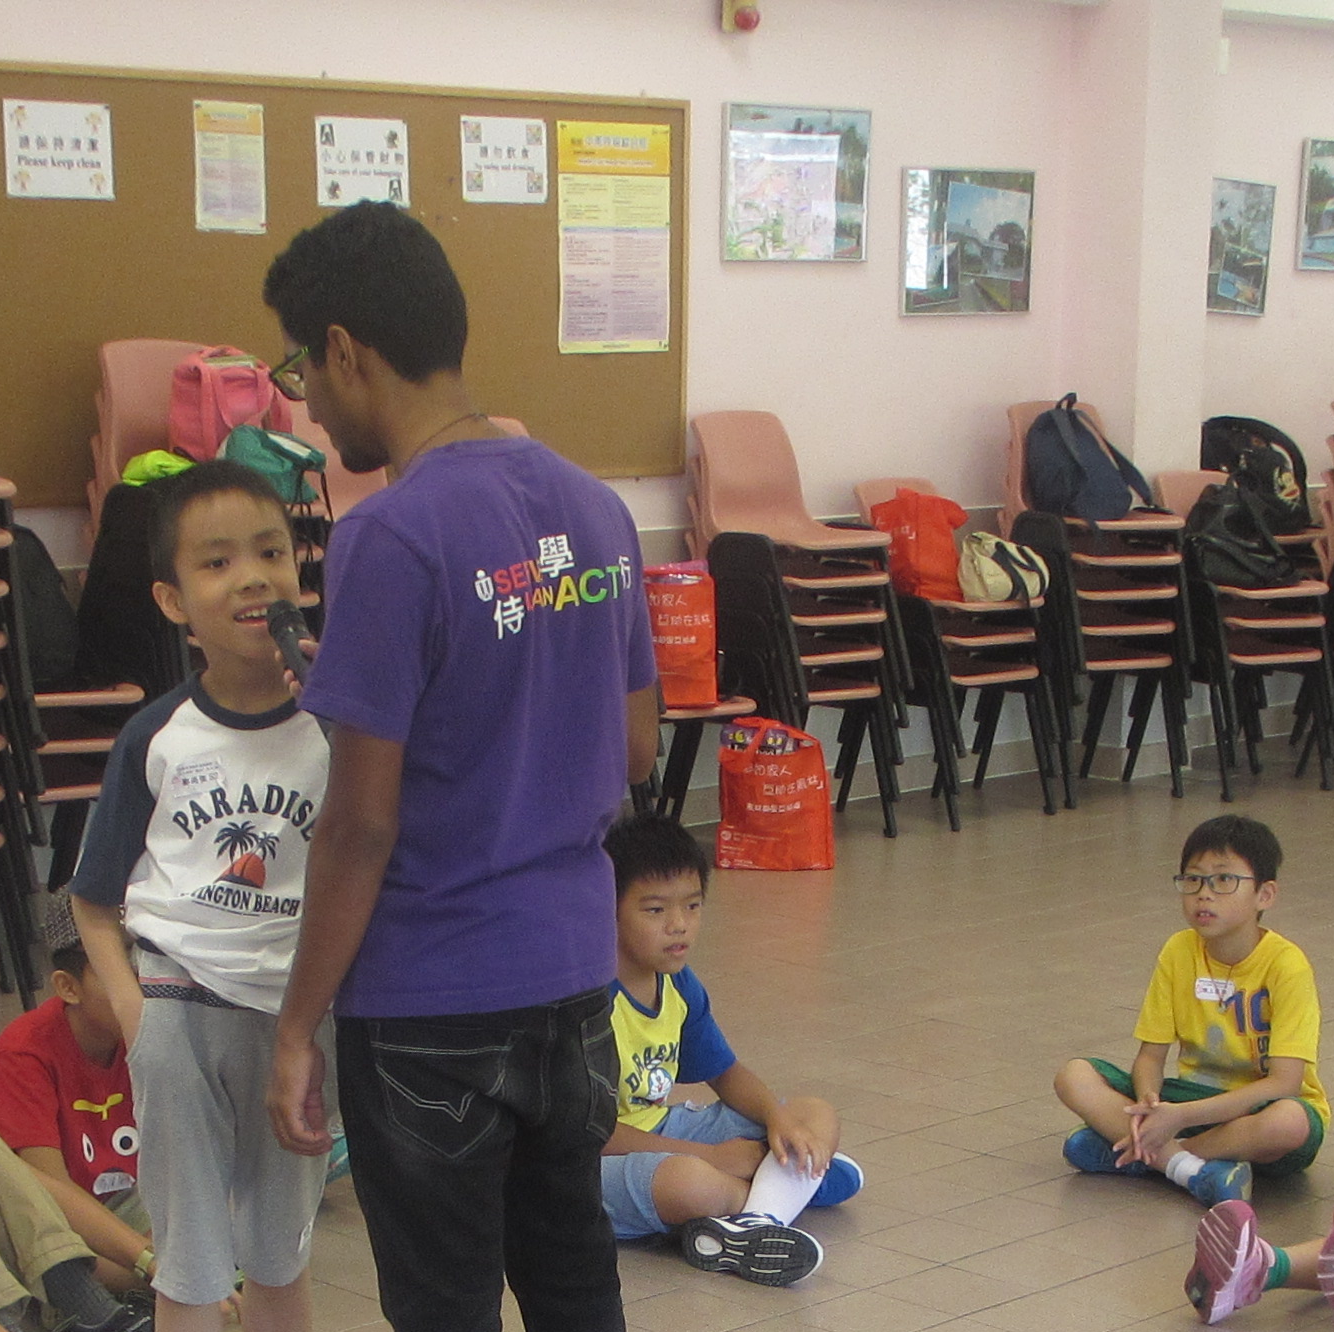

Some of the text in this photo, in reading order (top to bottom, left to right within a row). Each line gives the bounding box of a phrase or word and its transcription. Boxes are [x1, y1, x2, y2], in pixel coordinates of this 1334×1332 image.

[538, 534, 575, 578] 學
[494, 595, 525, 640] 侍
[253, 891, 302, 917] BEACH
